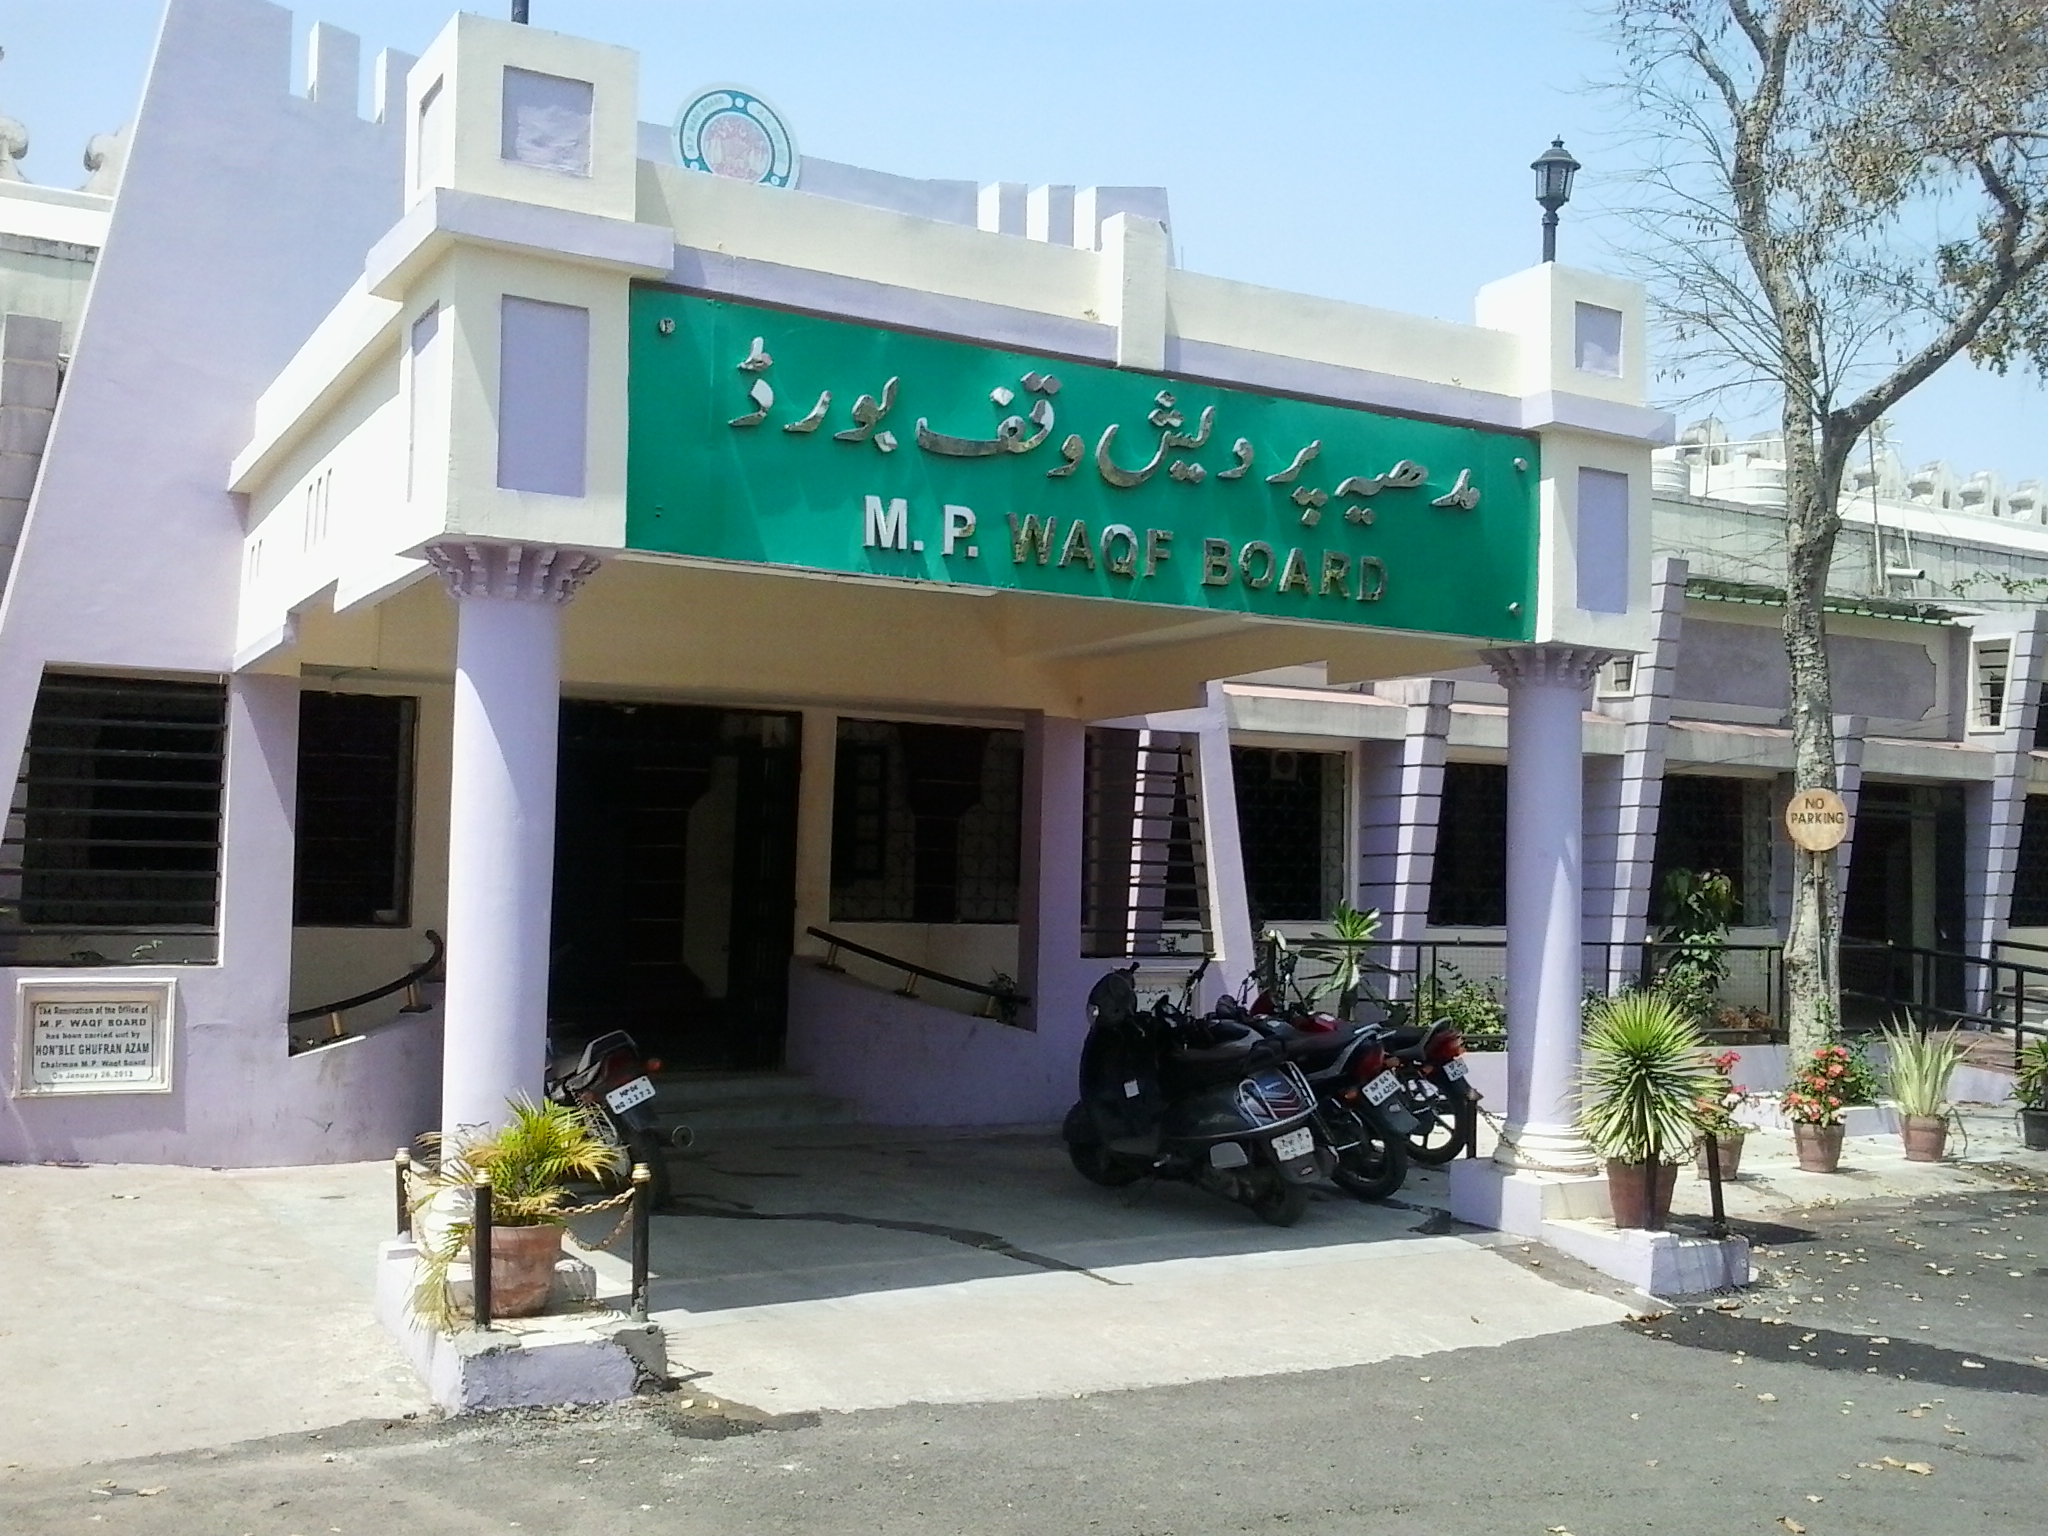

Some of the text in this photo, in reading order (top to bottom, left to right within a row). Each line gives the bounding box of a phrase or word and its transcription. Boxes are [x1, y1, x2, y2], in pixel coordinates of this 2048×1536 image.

[728, 336, 899, 454] بورڈ
[915, 370, 1086, 479] وقف
[1006, 510, 1174, 579] WAQF
[1200, 536, 1389, 602] BOARD
[1790, 798, 1845, 825] NO PARKING
[35, 1043, 149, 1056] HON'BLE GHUFRAN AZAM
[70, 1019, 104, 1028] WAQF
[108, 1018, 147, 1028] BOARD
